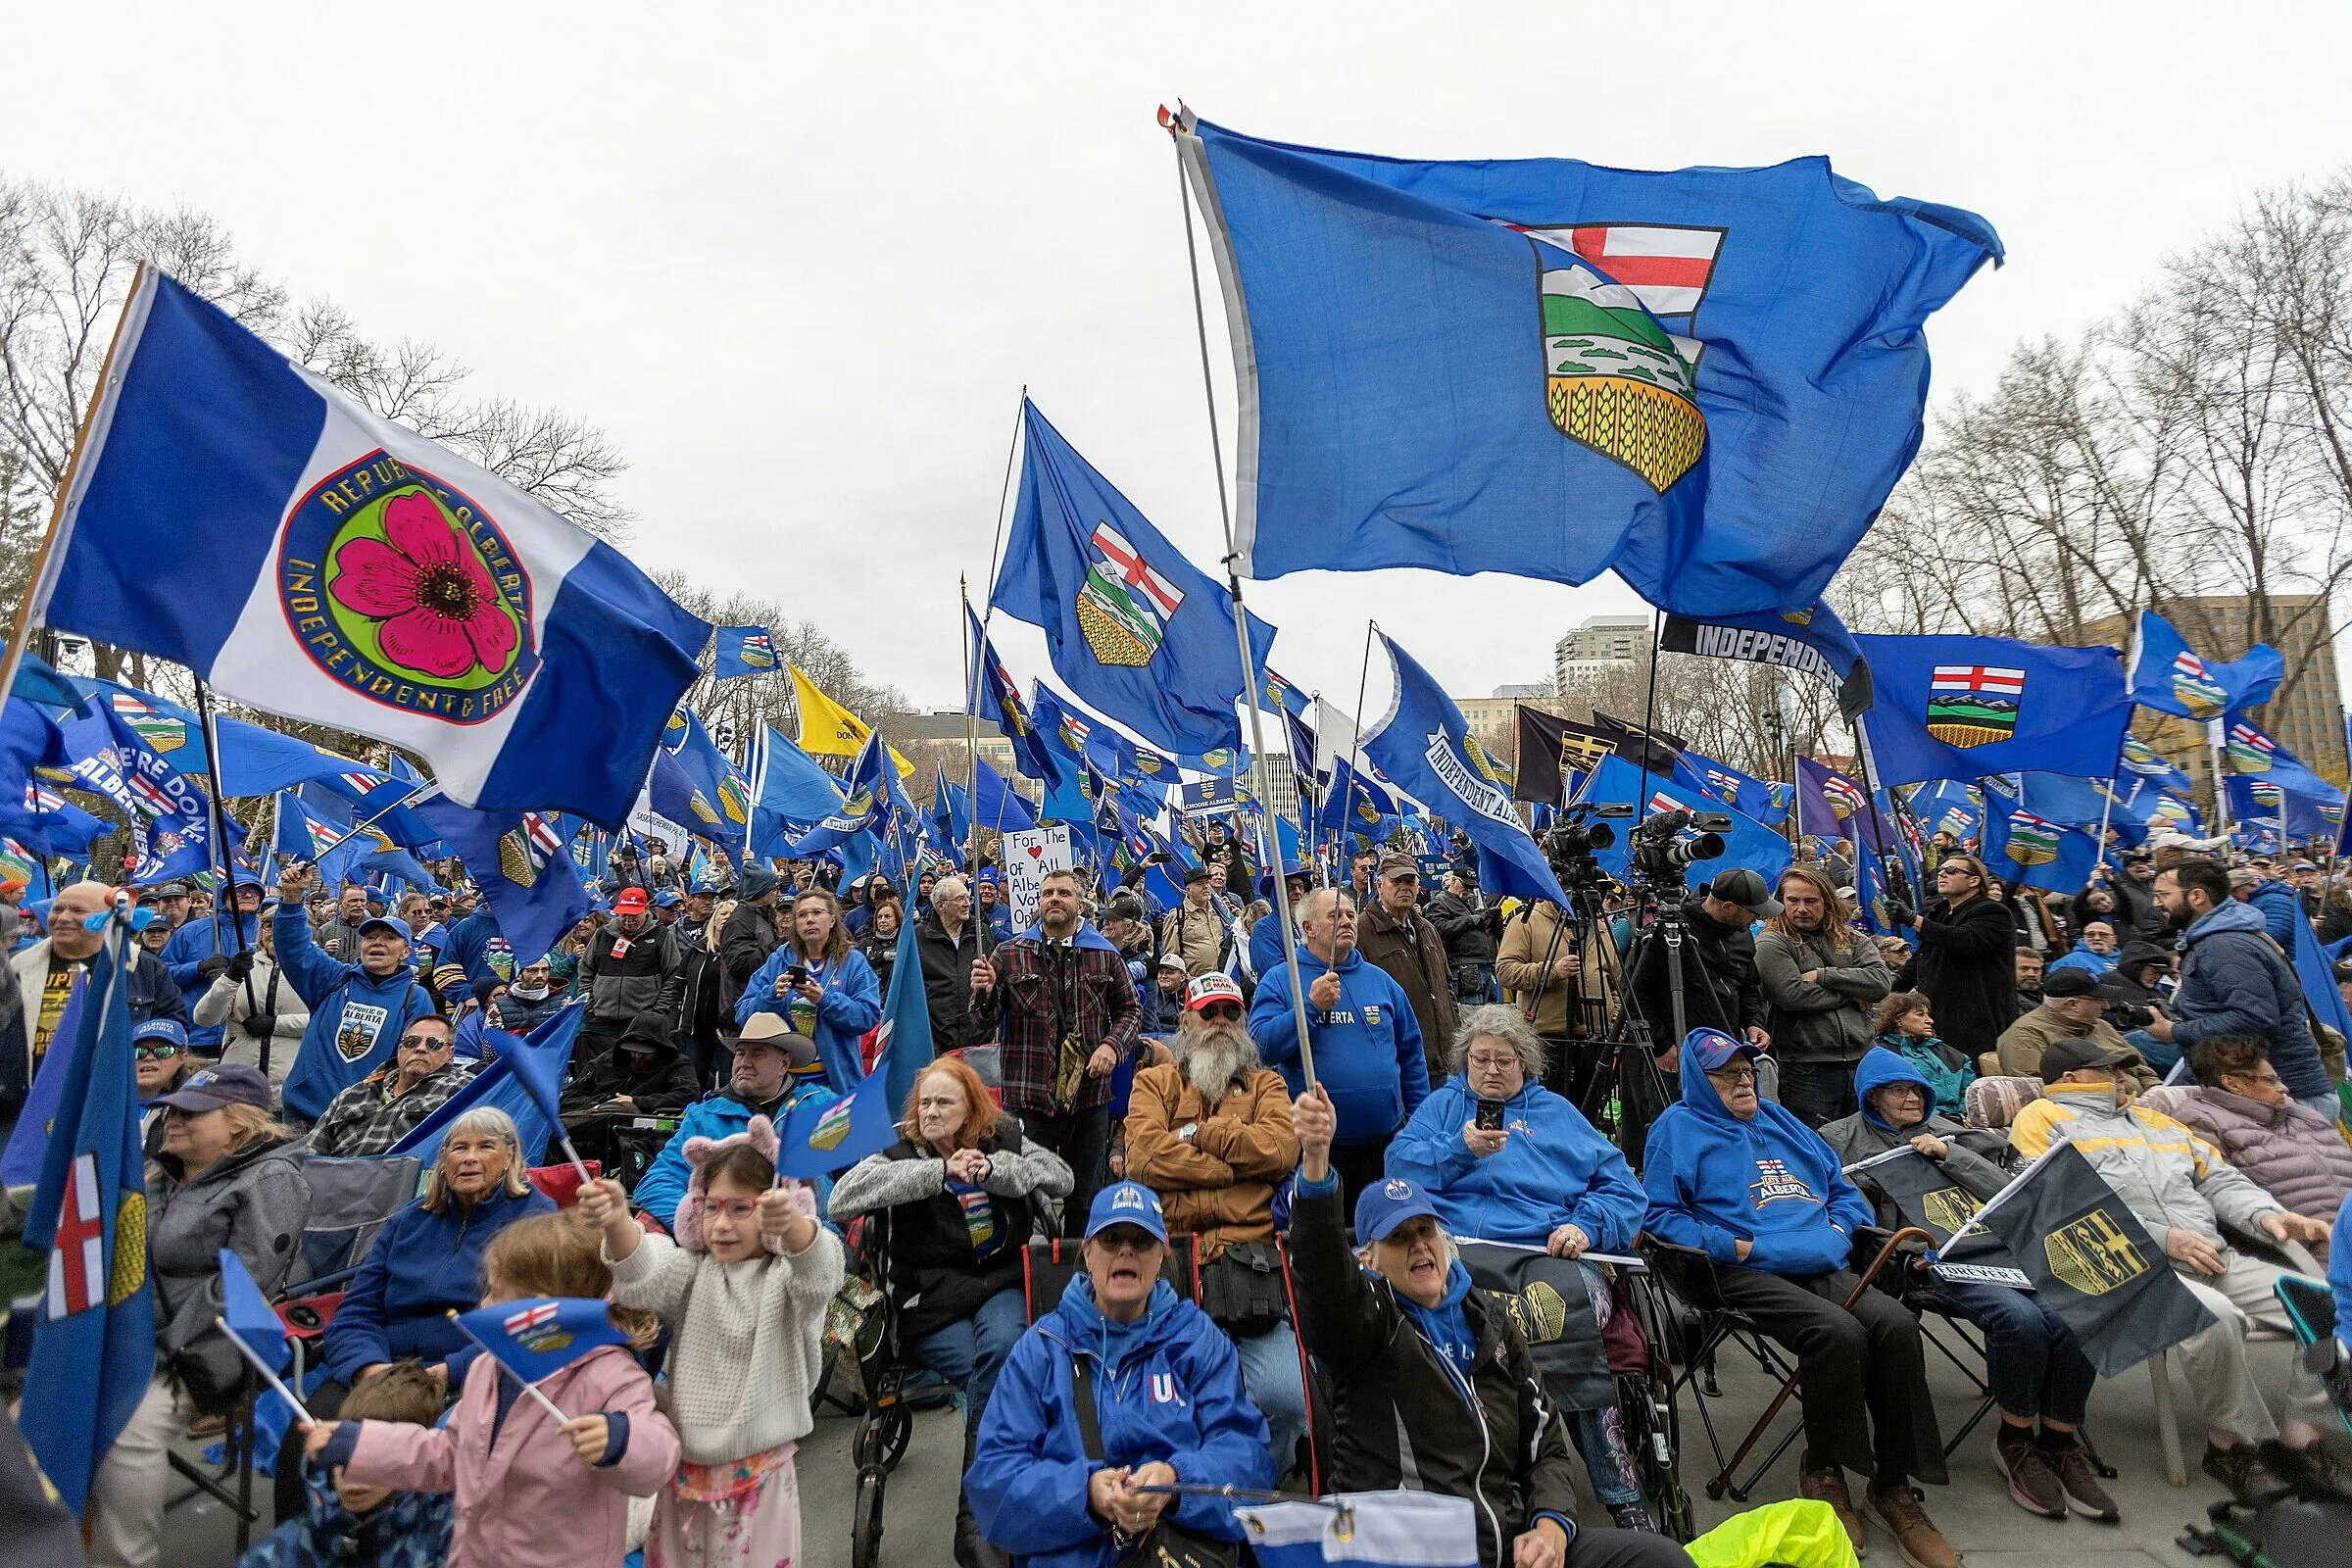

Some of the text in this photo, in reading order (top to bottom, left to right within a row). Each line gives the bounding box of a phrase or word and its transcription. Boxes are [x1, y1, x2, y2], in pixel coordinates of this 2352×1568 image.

[286, 558, 525, 718] INDEPENDENT & FREE
[1431, 745, 1496, 812] INDEPENDENT
[114, 741, 170, 781] E'RE
[165, 775, 206, 844] DONE
[1013, 828, 1066, 849] For The
[1012, 877, 1040, 893] Albe
[1016, 893, 1041, 906] Vot
[1014, 907, 1035, 927] Opt
[343, 1010, 382, 1025] ALBERTA
[346, 1004, 376, 1015] REPUBLIC
[1760, 1184, 1812, 1199] ALBERTA
[1937, 1265, 2011, 1280] FOREVER
